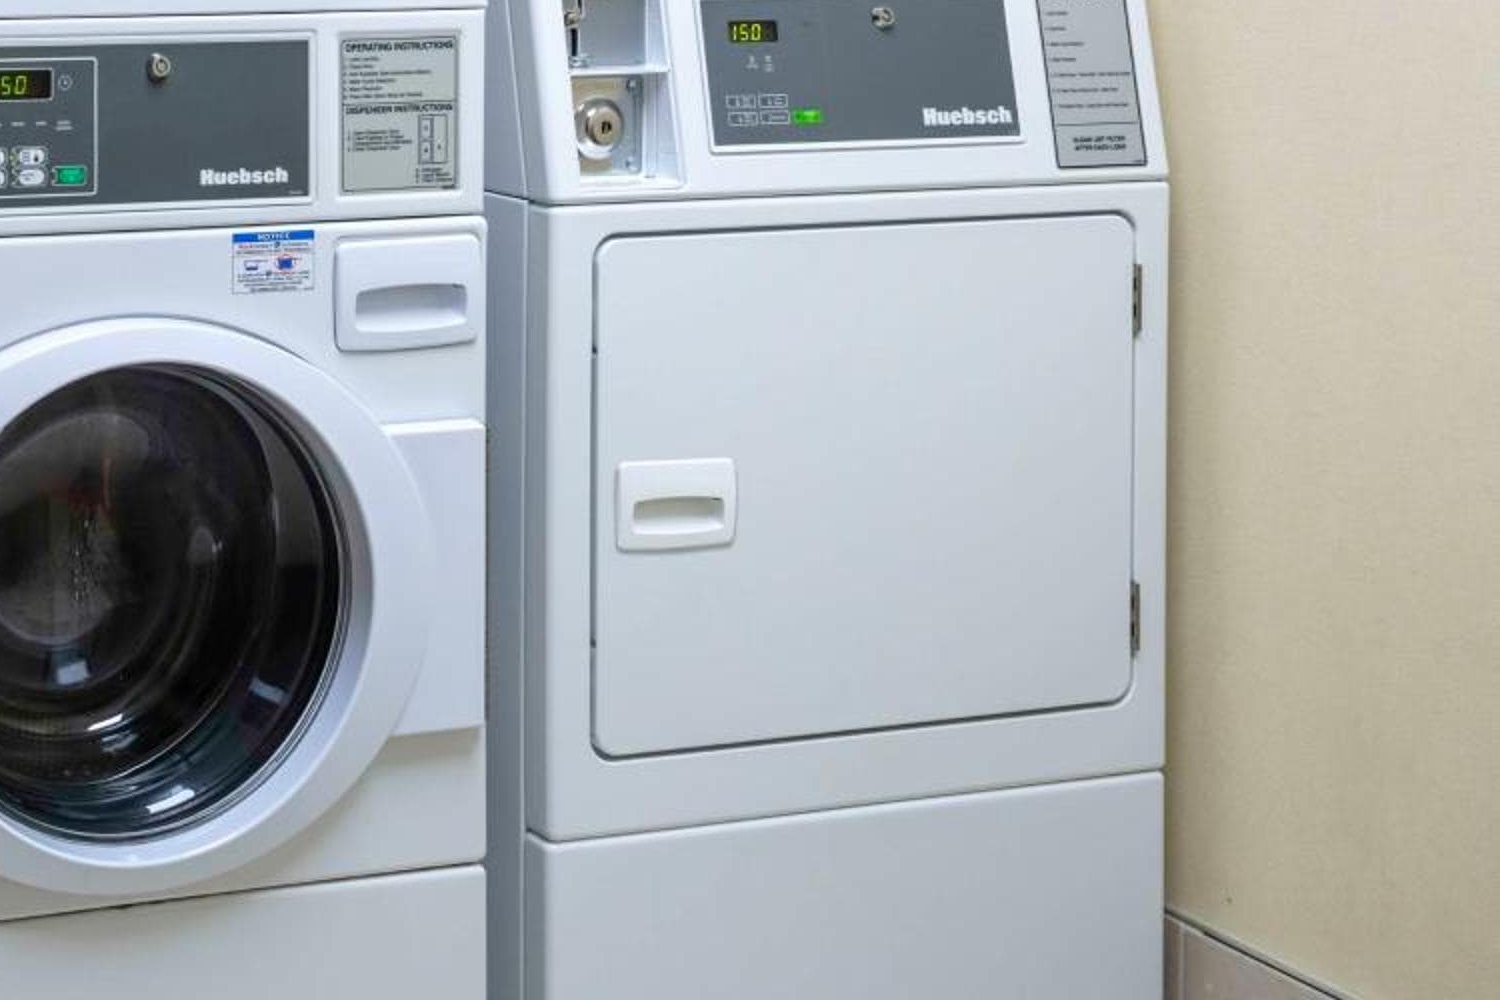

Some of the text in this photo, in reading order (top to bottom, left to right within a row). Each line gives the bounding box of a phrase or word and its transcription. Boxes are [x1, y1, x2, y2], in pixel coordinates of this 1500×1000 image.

[732, 23, 761, 41] 150
[345, 40, 453, 53] OPERATING INSTRUCTIONS
[393, 102, 453, 113] INSTRUCTIONS
[922, 105, 1013, 127] Huebsch
[199, 166, 289, 186] Huebsch
